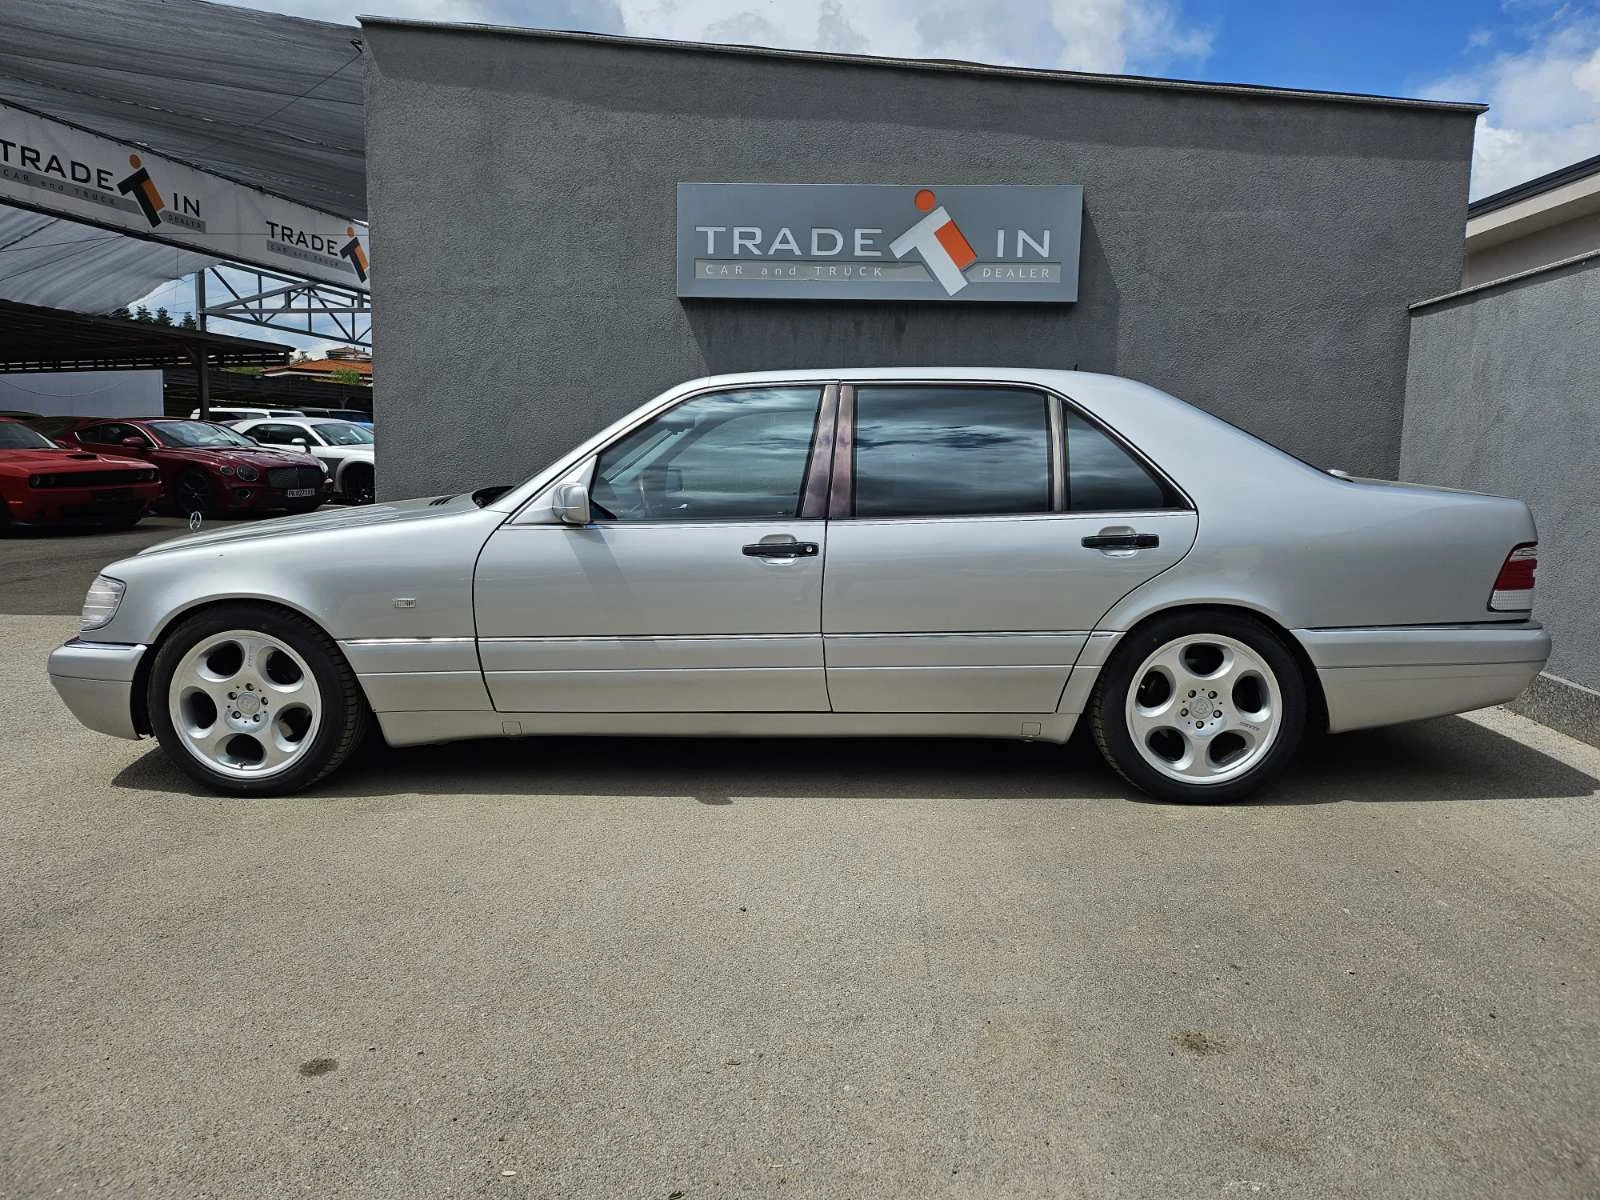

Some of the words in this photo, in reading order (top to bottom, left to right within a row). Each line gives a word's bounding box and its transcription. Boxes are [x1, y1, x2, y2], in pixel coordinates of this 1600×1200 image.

[0, 138, 114, 191] TRADE
[173, 192, 200, 217] IN
[265, 220, 338, 257] TRADE
[695, 226, 882, 257] TRADE
[996, 229, 1051, 258] IN
[705, 264, 744, 275] CAR
[760, 266, 798, 277] and
[815, 265, 883, 277] TRUCK
[983, 267, 1050, 279] DEALER
